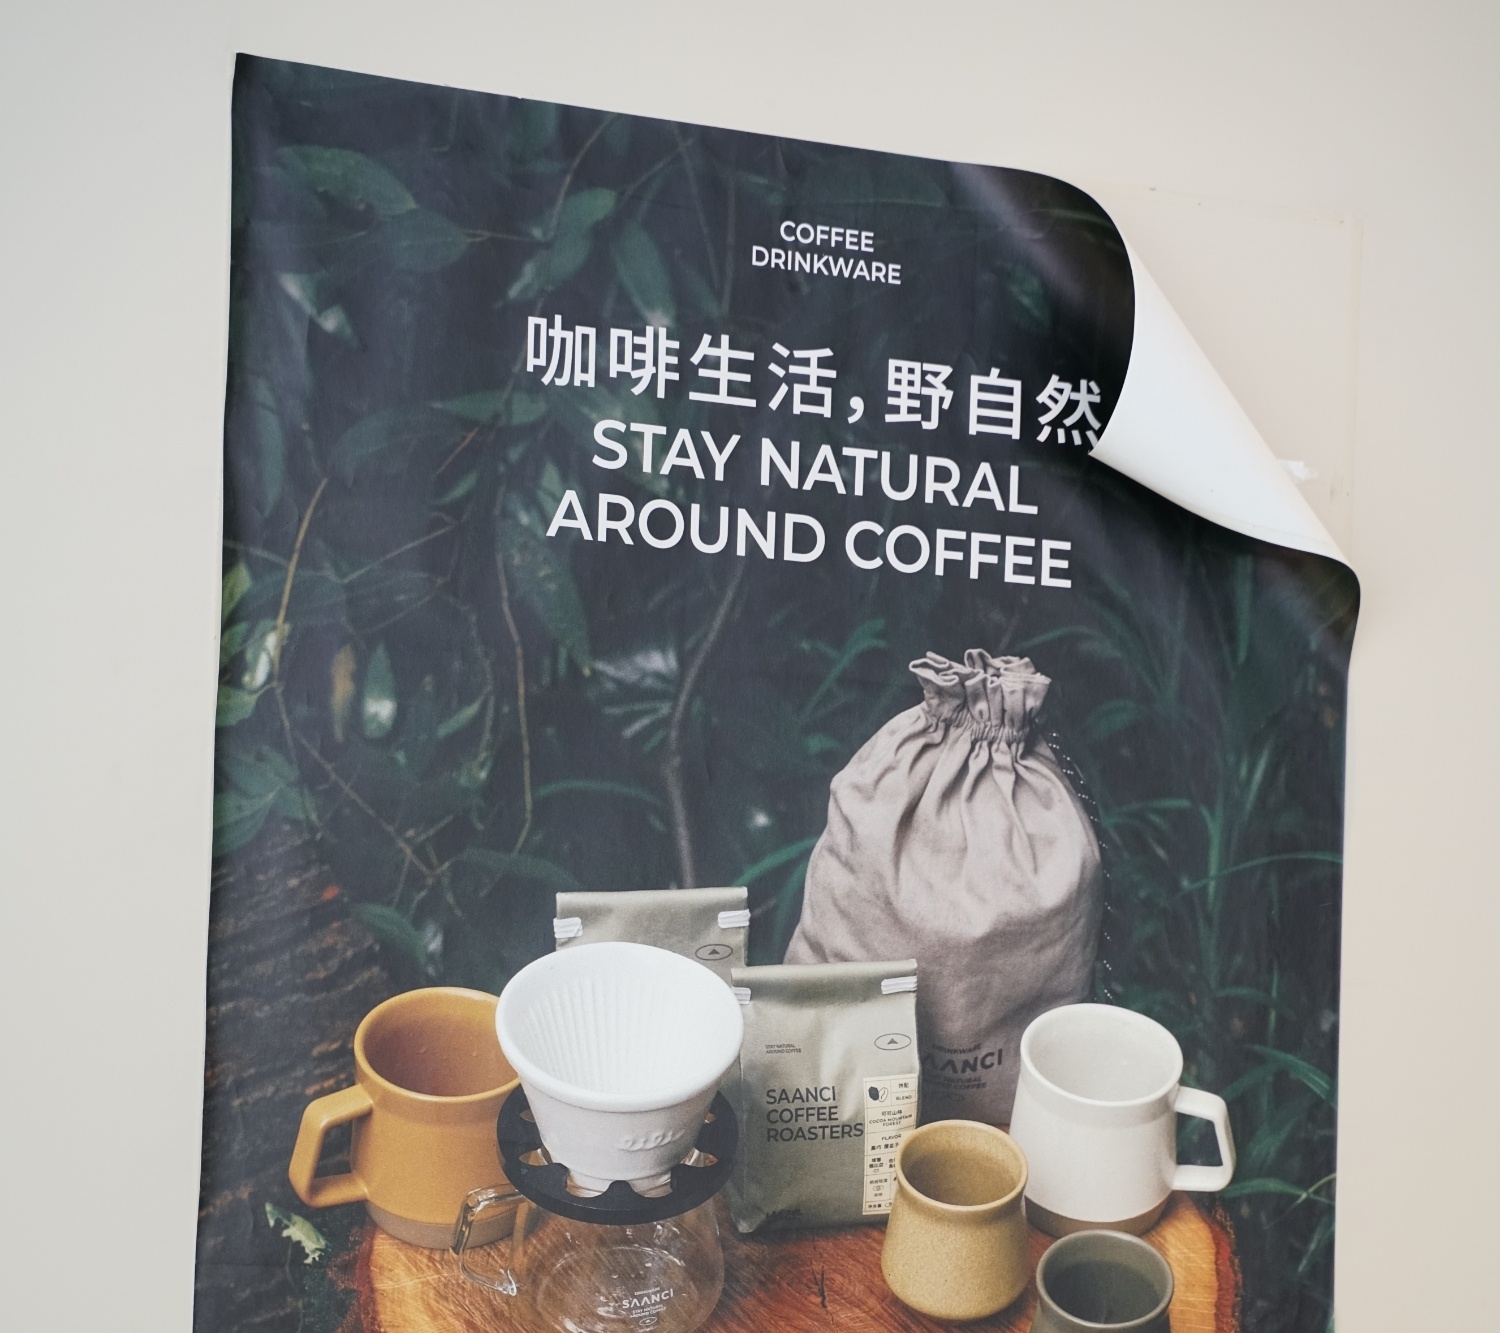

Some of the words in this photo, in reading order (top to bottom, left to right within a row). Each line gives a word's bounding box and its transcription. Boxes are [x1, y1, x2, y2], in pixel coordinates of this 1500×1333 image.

[780, 220, 874, 253] COFFEE
[752, 245, 901, 285] DRINKWARE
[592, 420, 740, 481] STAY
[760, 437, 1038, 515] NATURAL
[546, 490, 825, 564] AROUND
[845, 521, 1072, 588] COFFEE
[766, 1086, 835, 1104] SAANCI
[766, 1106, 838, 1124] COFFEE
[869, 1117, 886, 1125] COCOA
[767, 1122, 864, 1142] ROASTERS
[881, 1133, 902, 1141] FLAVOR
[622, 1288, 674, 1309] SAANCI
